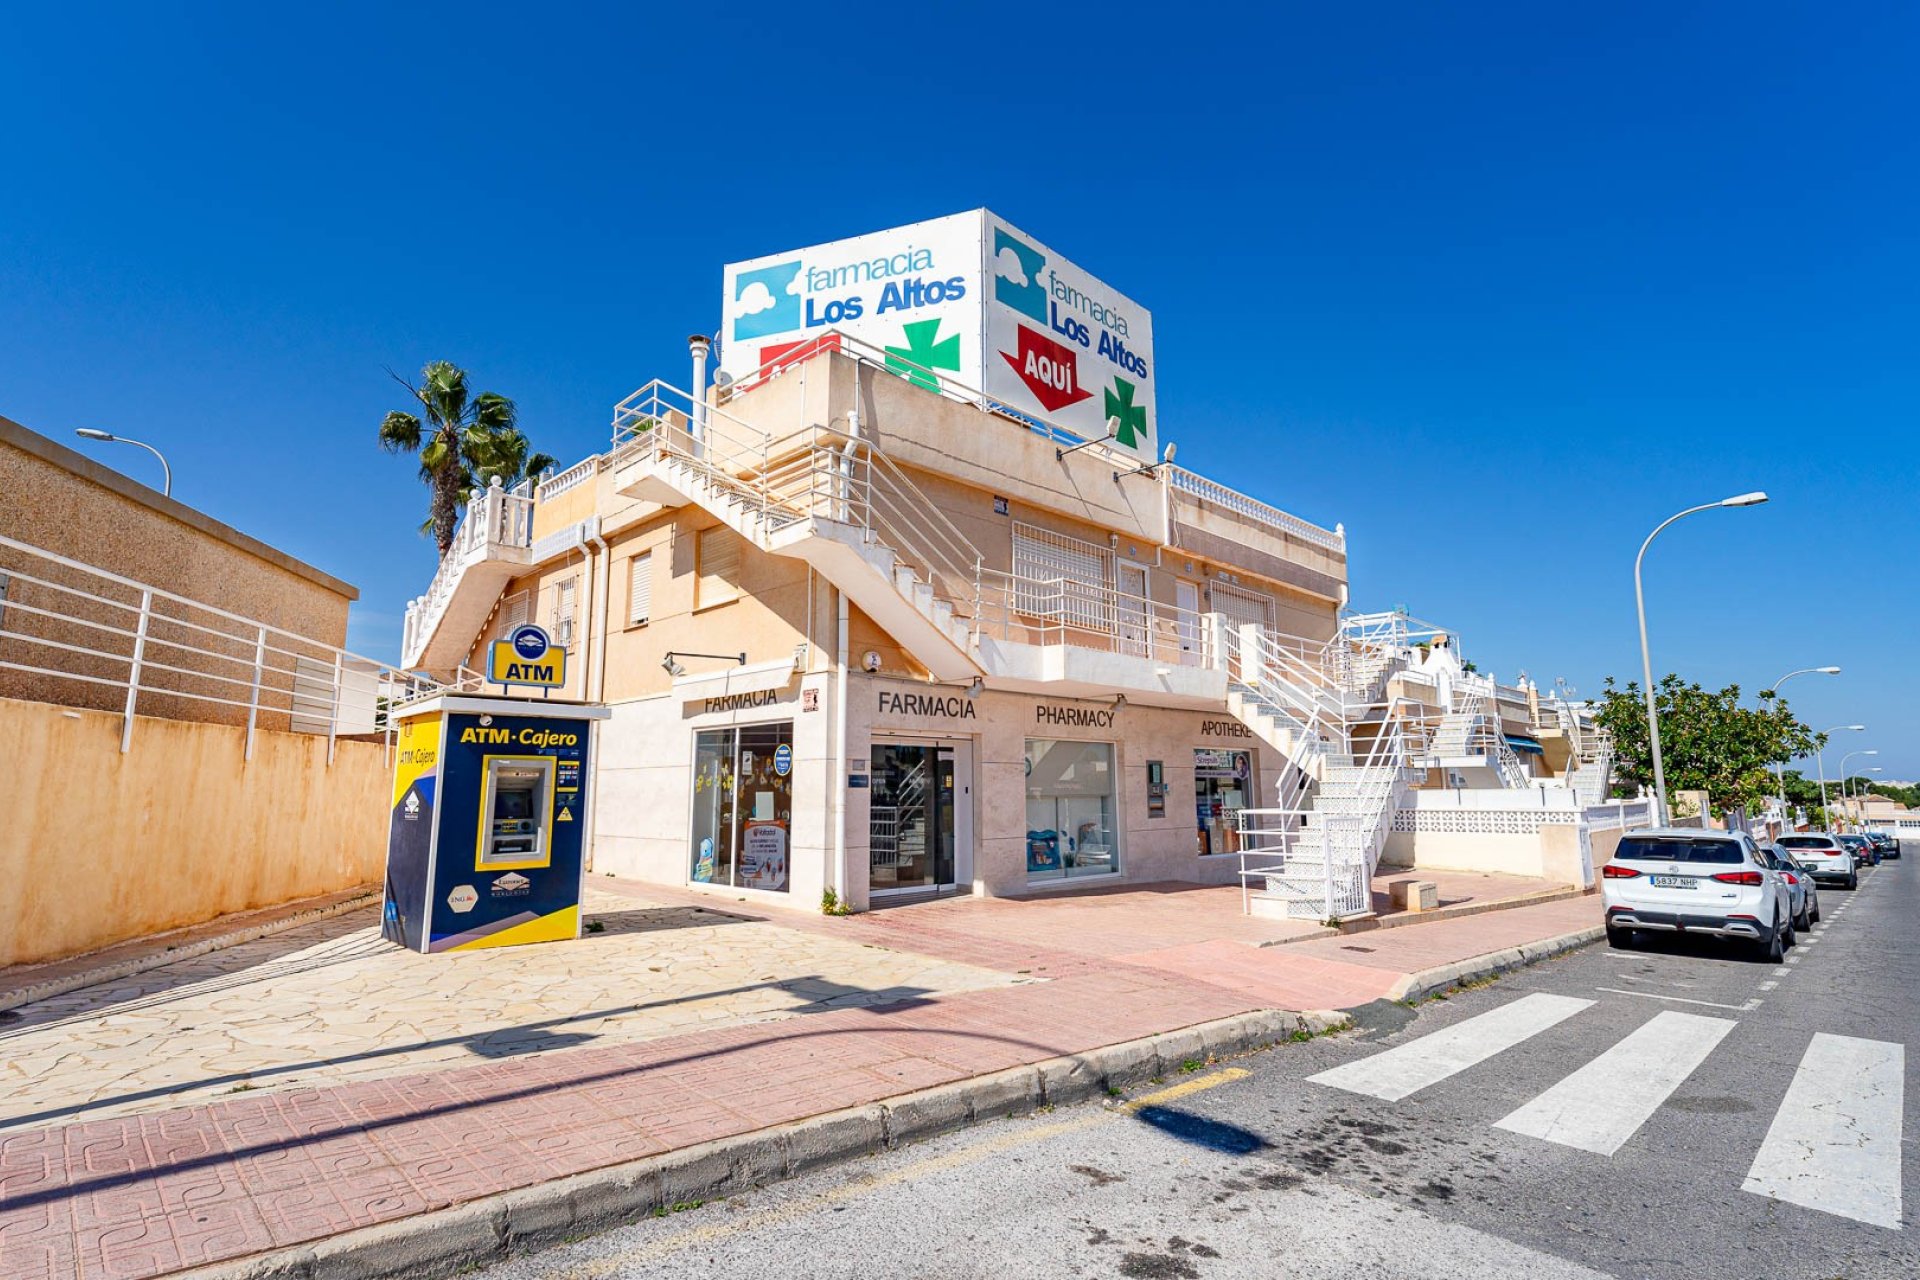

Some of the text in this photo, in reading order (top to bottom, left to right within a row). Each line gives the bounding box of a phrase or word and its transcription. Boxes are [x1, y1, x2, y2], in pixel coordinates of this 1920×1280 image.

[806, 245, 935, 293] farmacia
[806, 276, 966, 328] Los Altos
[1049, 270, 1130, 339] farmacia
[1051, 300, 1148, 379] Los Altos
[1024, 349, 1072, 394] AQUÍ
[505, 663, 553, 681] ATM
[705, 689, 777, 713] FARMACIA
[879, 691, 976, 719] FARMACIA
[1036, 705, 1115, 728] PHARMACY
[1656, 876, 1677, 885] 5837
